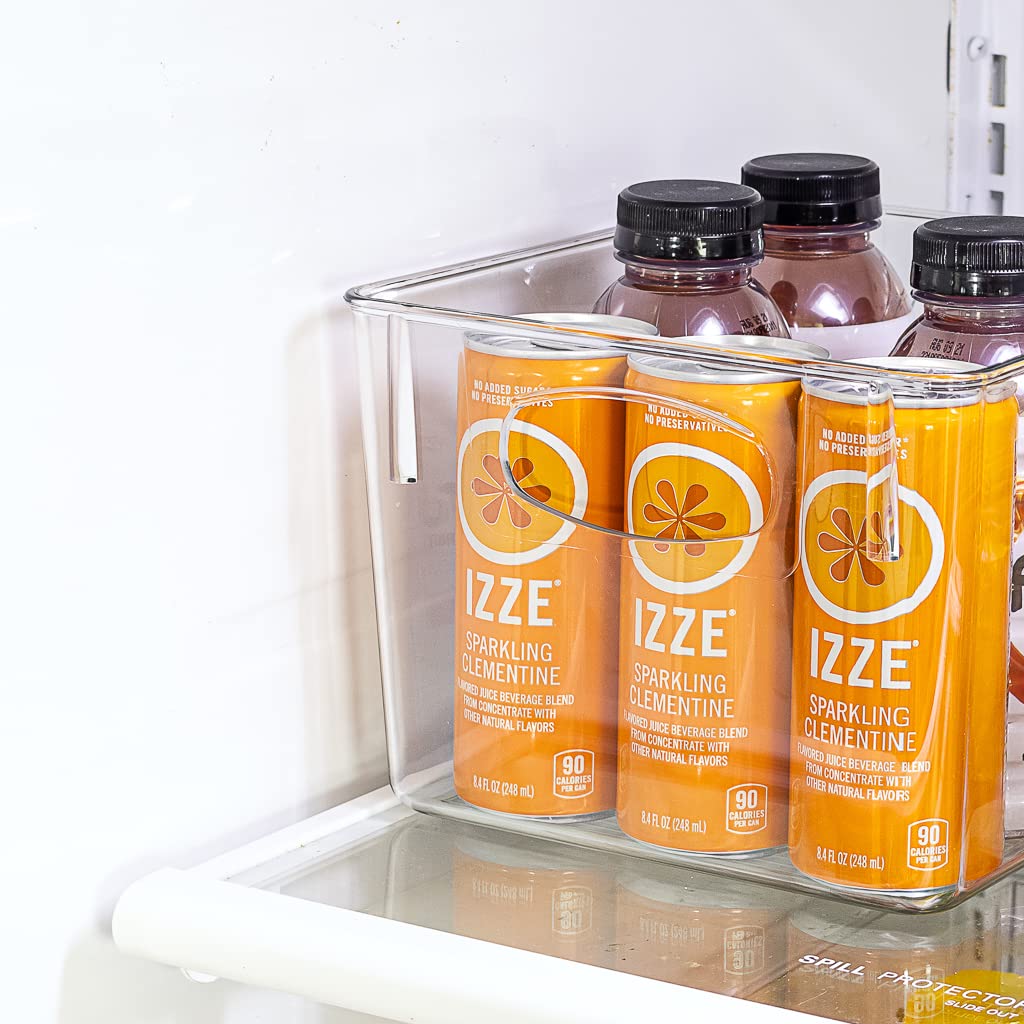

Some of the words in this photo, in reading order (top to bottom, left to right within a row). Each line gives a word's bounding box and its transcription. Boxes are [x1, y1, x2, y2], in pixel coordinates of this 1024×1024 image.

[472, 390, 480, 401] NO
[474, 379, 483, 390] NO
[485, 382, 511, 395] ADDED
[644, 413, 654, 424] NO
[819, 440, 829, 451] NO
[822, 428, 833, 440] NO
[835, 431, 866, 444] ADDED
[466, 567, 554, 626] IZZE
[634, 597, 728, 658] IZZE
[466, 630, 553, 662] SPARKLING
[462, 652, 561, 686] CLEMENTINE
[810, 627, 912, 690] IZZE
[634, 662, 727, 694] SPARKLING
[463, 694, 478, 709] FROM
[478, 699, 532, 719] CONCENTRATE
[534, 708, 557, 719] WITH
[479, 688, 498, 701] JUICE
[500, 691, 543, 705] BEVERAGE
[545, 694, 575, 706] BLEND
[629, 685, 735, 718] CLEMENTINE
[463, 708, 481, 724] OTHER
[481, 714, 516, 731] NATURAL
[516, 720, 555, 733] FLAVORS
[809, 693, 910, 727] SPARKLING
[623, 708, 648, 729] FLAVORED
[649, 721, 669, 734] JUICE
[671, 725, 716, 738] BEVERAGE
[719, 727, 748, 738] BLEND
[804, 716, 917, 752] CLEMENTINE
[630, 727, 647, 742] FROM
[647, 734, 705, 752] CONCENTRATE
[707, 742, 730, 753] WITH
[562, 754, 585, 775] 90
[631, 742, 651, 758] OTHER
[651, 749, 687, 765] NATURAL
[688, 754, 728, 766] FLAVORS
[797, 742, 824, 763] FLAVORED
[825, 753, 847, 768] JUICE
[848, 758, 896, 772] BEVERAGE
[901, 760, 931, 772] BLEND
[555, 775, 592, 785] CALORIES
[805, 760, 823, 777] FROM
[823, 766, 884, 786] CONCENTRATE
[885, 775, 912, 787] WITH
[482, 778, 491, 791] FL
[491, 781, 501, 794] OZ
[501, 782, 518, 797] (248
[519, 785, 535, 798] mL)
[561, 785, 573, 793] PER
[806, 776, 827, 792] OTHER
[827, 783, 865, 800] NATURAL
[866, 789, 910, 802] FLAVORS
[735, 789, 758, 810] 90
[652, 813, 660, 828] FL
[661, 816, 671, 829] OZ
[672, 817, 690, 832] (248
[691, 820, 707, 833] mL)
[728, 809, 765, 820] CALORIES
[734, 820, 747, 828] PER
[747, 819, 760, 827] CAN
[917, 824, 940, 846] 90
[827, 850, 836, 864] FL
[838, 852, 848, 866] OZ
[849, 854, 867, 869] (248
[869, 856, 885, 871] mL)
[910, 845, 947, 856] CALORIES
[915, 856, 929, 864] PER
[798, 954, 866, 977] SPILL
[944, 1000, 986, 1014] SLIDE
[986, 1008, 1021, 1020] OUT
